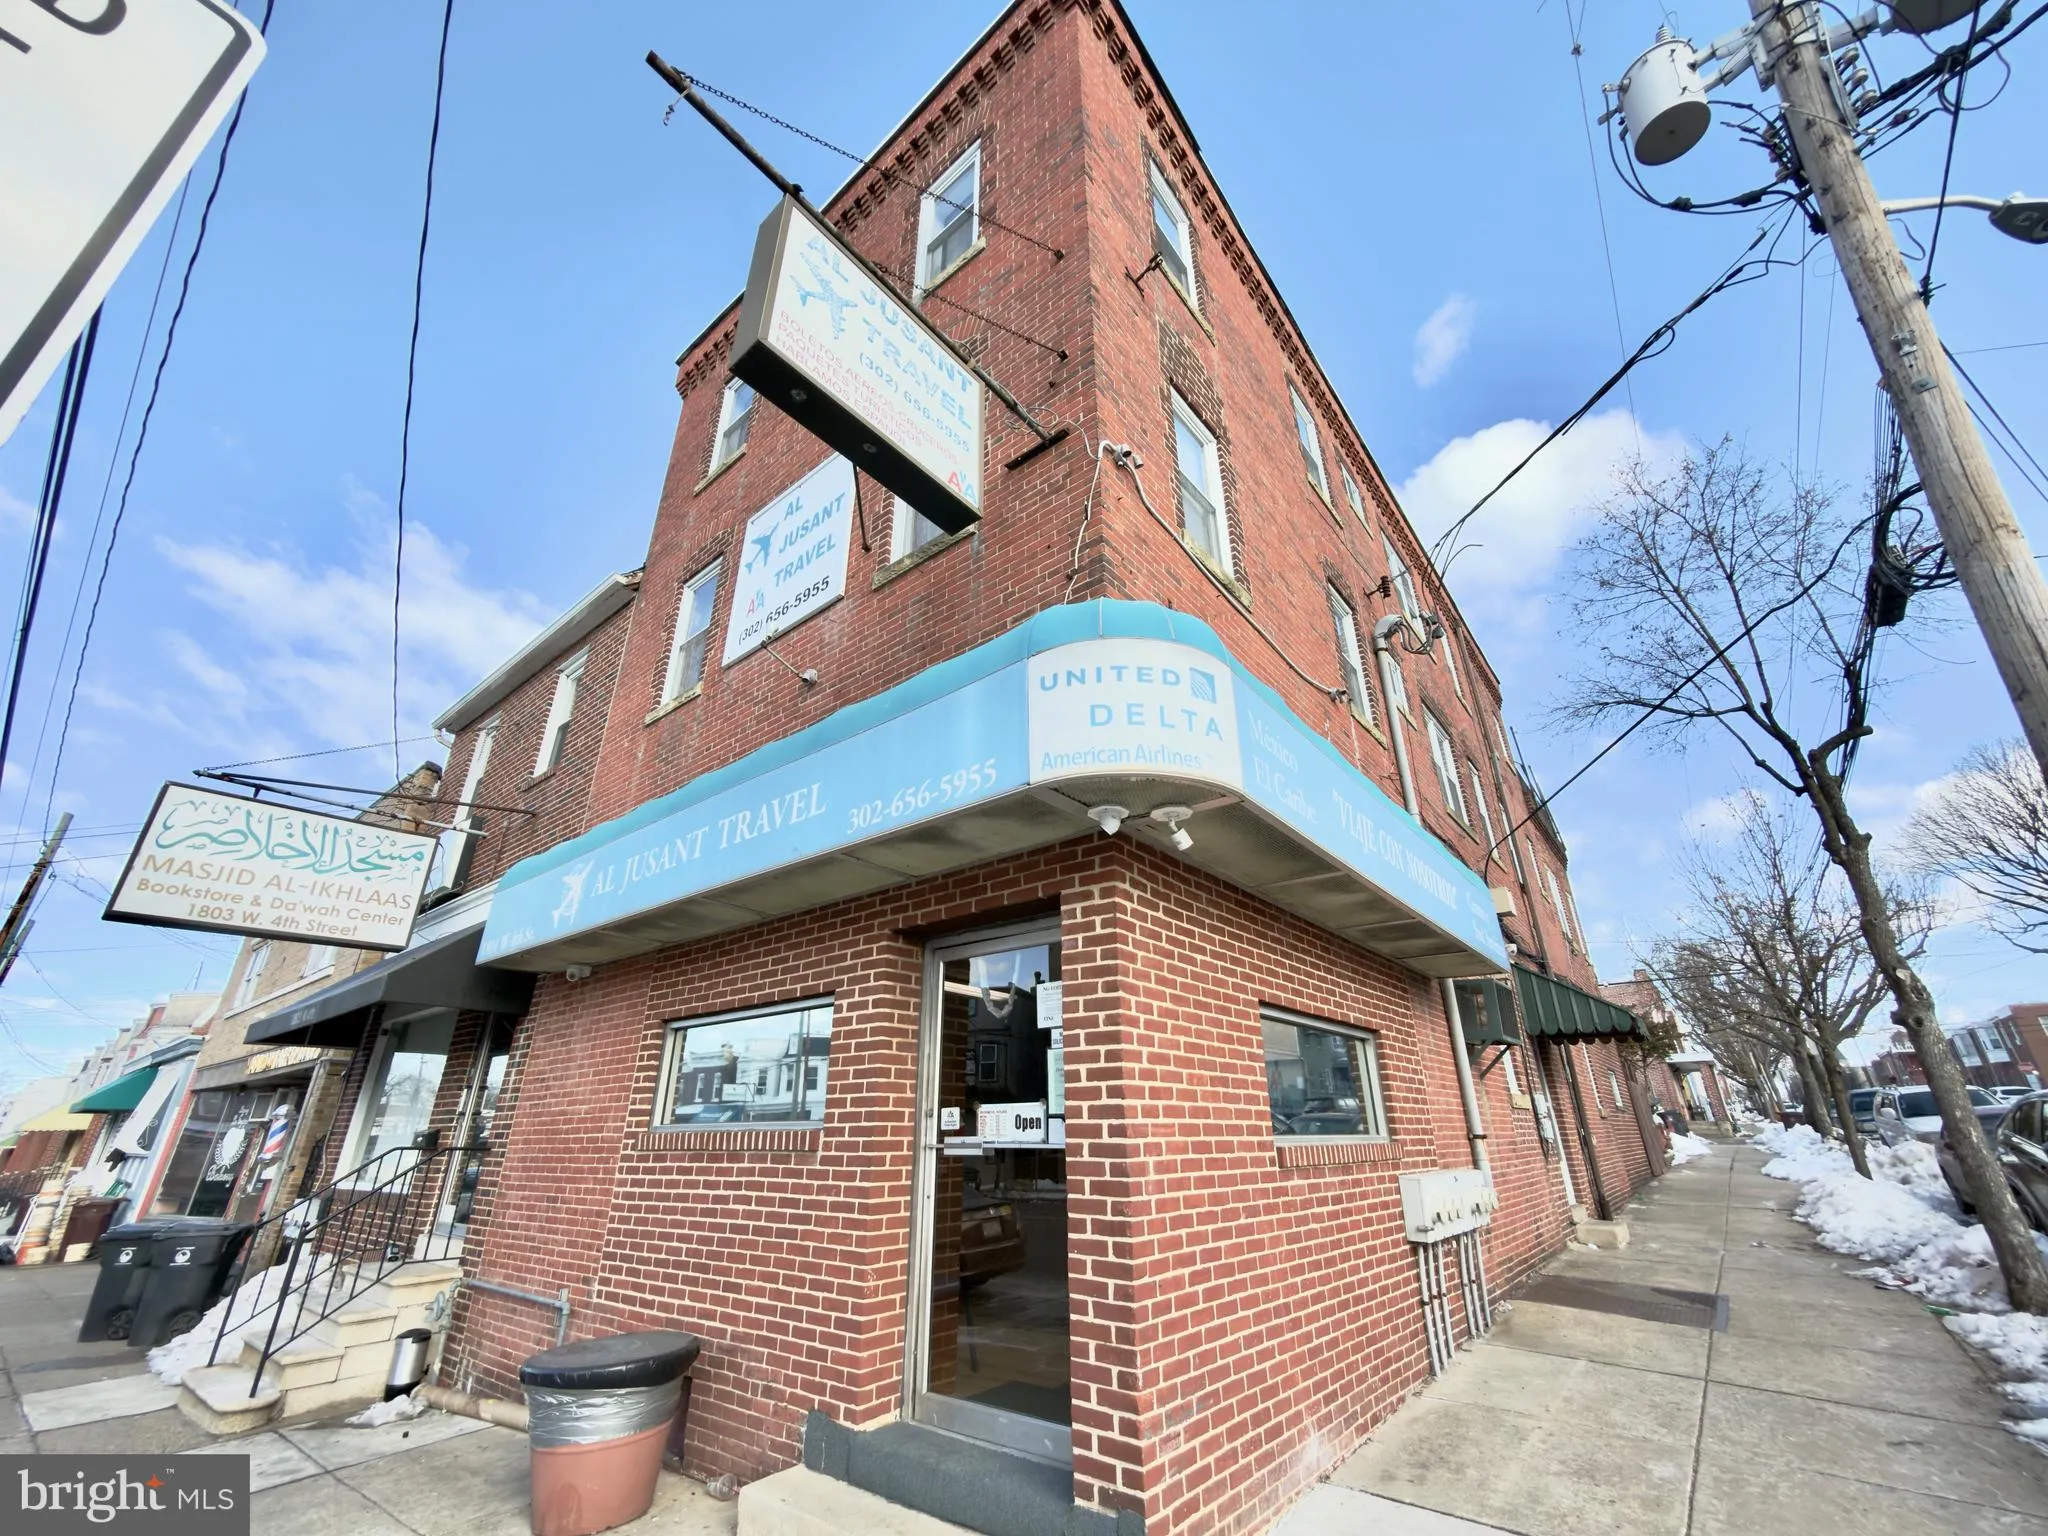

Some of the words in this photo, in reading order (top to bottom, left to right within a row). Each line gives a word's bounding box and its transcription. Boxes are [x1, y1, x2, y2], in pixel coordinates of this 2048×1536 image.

[780, 310, 842, 370] BOLETOS
[806, 236, 848, 283] AL
[860, 287, 972, 392] JUSANT
[776, 333, 850, 402] HABLAMOS
[778, 322, 849, 389] PAQUETES
[862, 317, 972, 430] TRAVEL
[859, 352, 899, 393] (302)
[903, 390, 970, 453] 656-5955
[778, 492, 845, 554] JUSANT
[784, 496, 803, 522] AL
[774, 534, 836, 588] TRAVEL
[738, 617, 763, 646] (302)
[765, 575, 830, 625] 656-5955
[1039, 665, 1181, 691] UNITED
[1090, 703, 1223, 741] DELTA
[1041, 747, 1131, 771] American
[1135, 744, 1202, 769] Airlines
[846, 758, 998, 835] 302-656-5955
[590, 868, 619, 897] AL
[619, 827, 711, 896] JUSANT
[718, 782, 826, 849] TRAVEL
[136, 878, 244, 905] Bookstore
[244, 895, 262, 908] &
[270, 896, 340, 919] Da'wah
[346, 907, 404, 927] Center
[142, 854, 256, 886] MASJID
[264, 874, 412, 911] AL-IKHLAAS
[186, 903, 235, 921] 1803
[241, 911, 263, 926] W.
[271, 915, 300, 930] 4th
[305, 918, 358, 938] Street
[1014, 1113, 1042, 1132] Open
